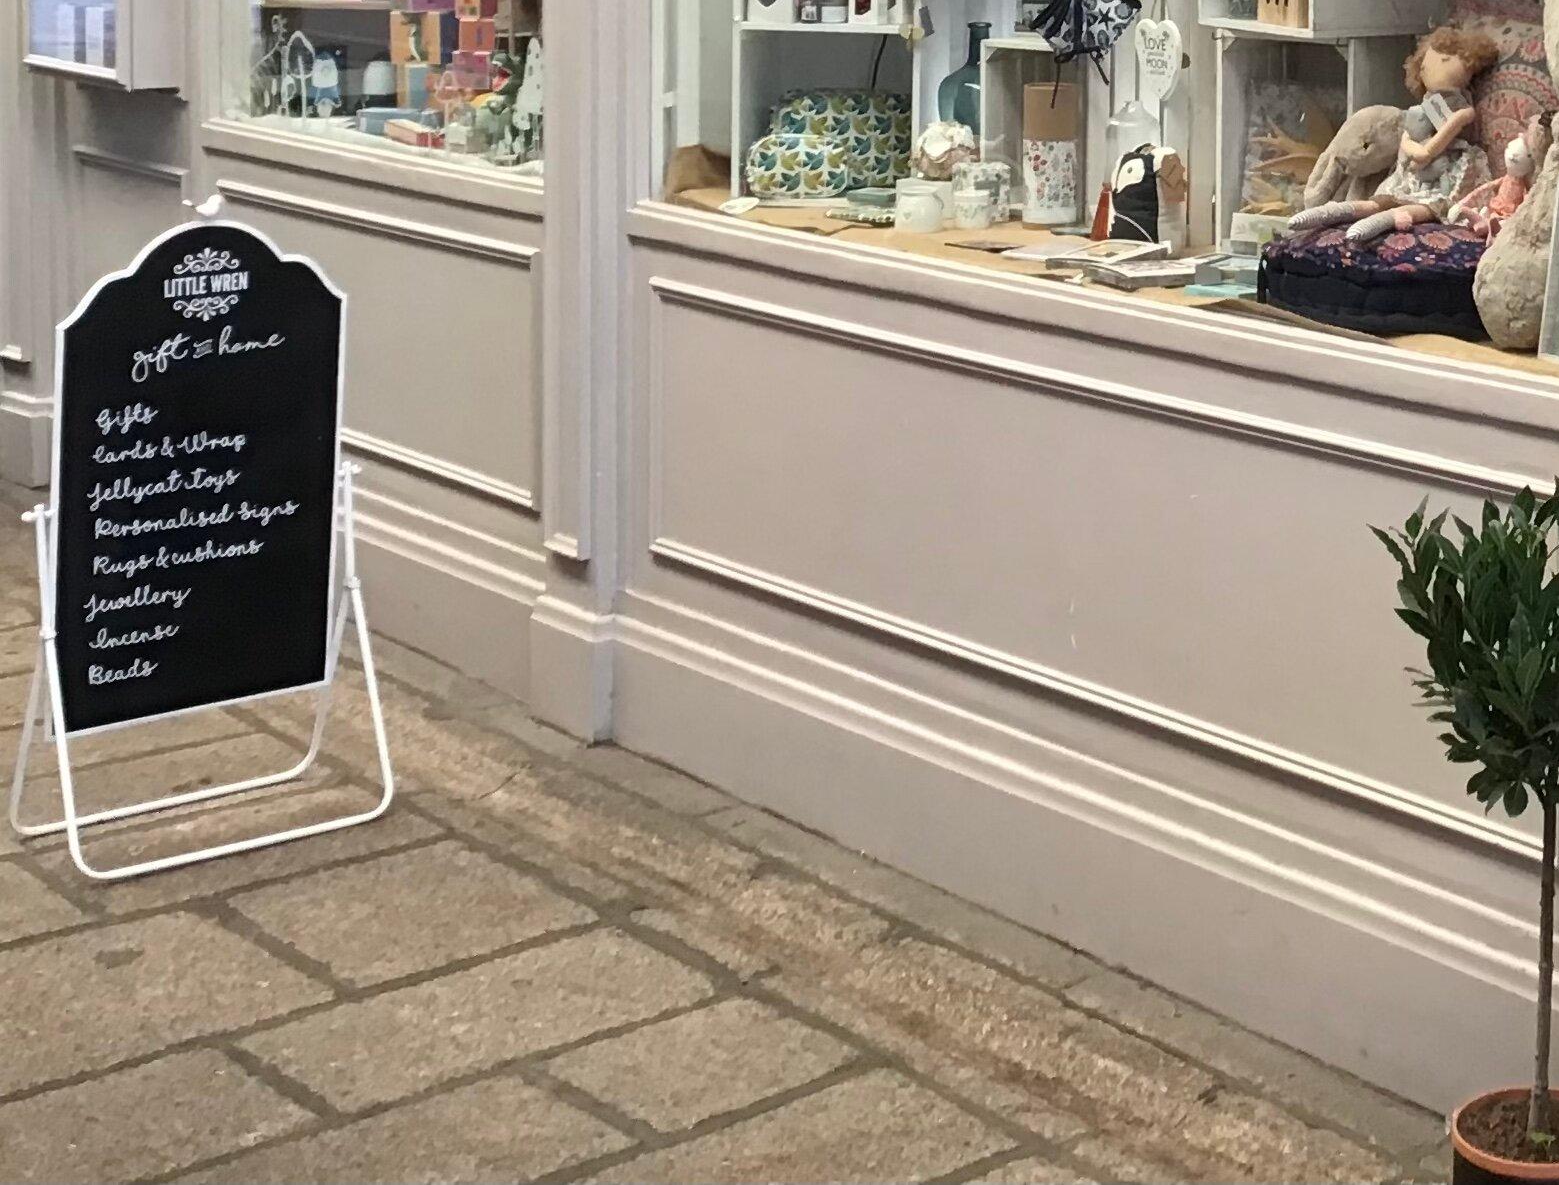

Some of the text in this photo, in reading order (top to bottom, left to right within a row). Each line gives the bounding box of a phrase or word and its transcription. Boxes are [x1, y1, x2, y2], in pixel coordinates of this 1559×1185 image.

[1144, 37, 1166, 52] LOVE
[164, 271, 249, 299] LITTLE WREN
[131, 333, 191, 383] gift
[218, 325, 286, 355] home
[95, 402, 159, 436] Gifts
[92, 430, 247, 464] Cards & Wrap
[94, 503, 236, 540] Personalised
[93, 555, 154, 579] Rugs
[156, 546, 171, 569] &
[83, 584, 192, 623] Jewellery
[89, 624, 180, 650] Incense
[88, 658, 159, 685] Beads
